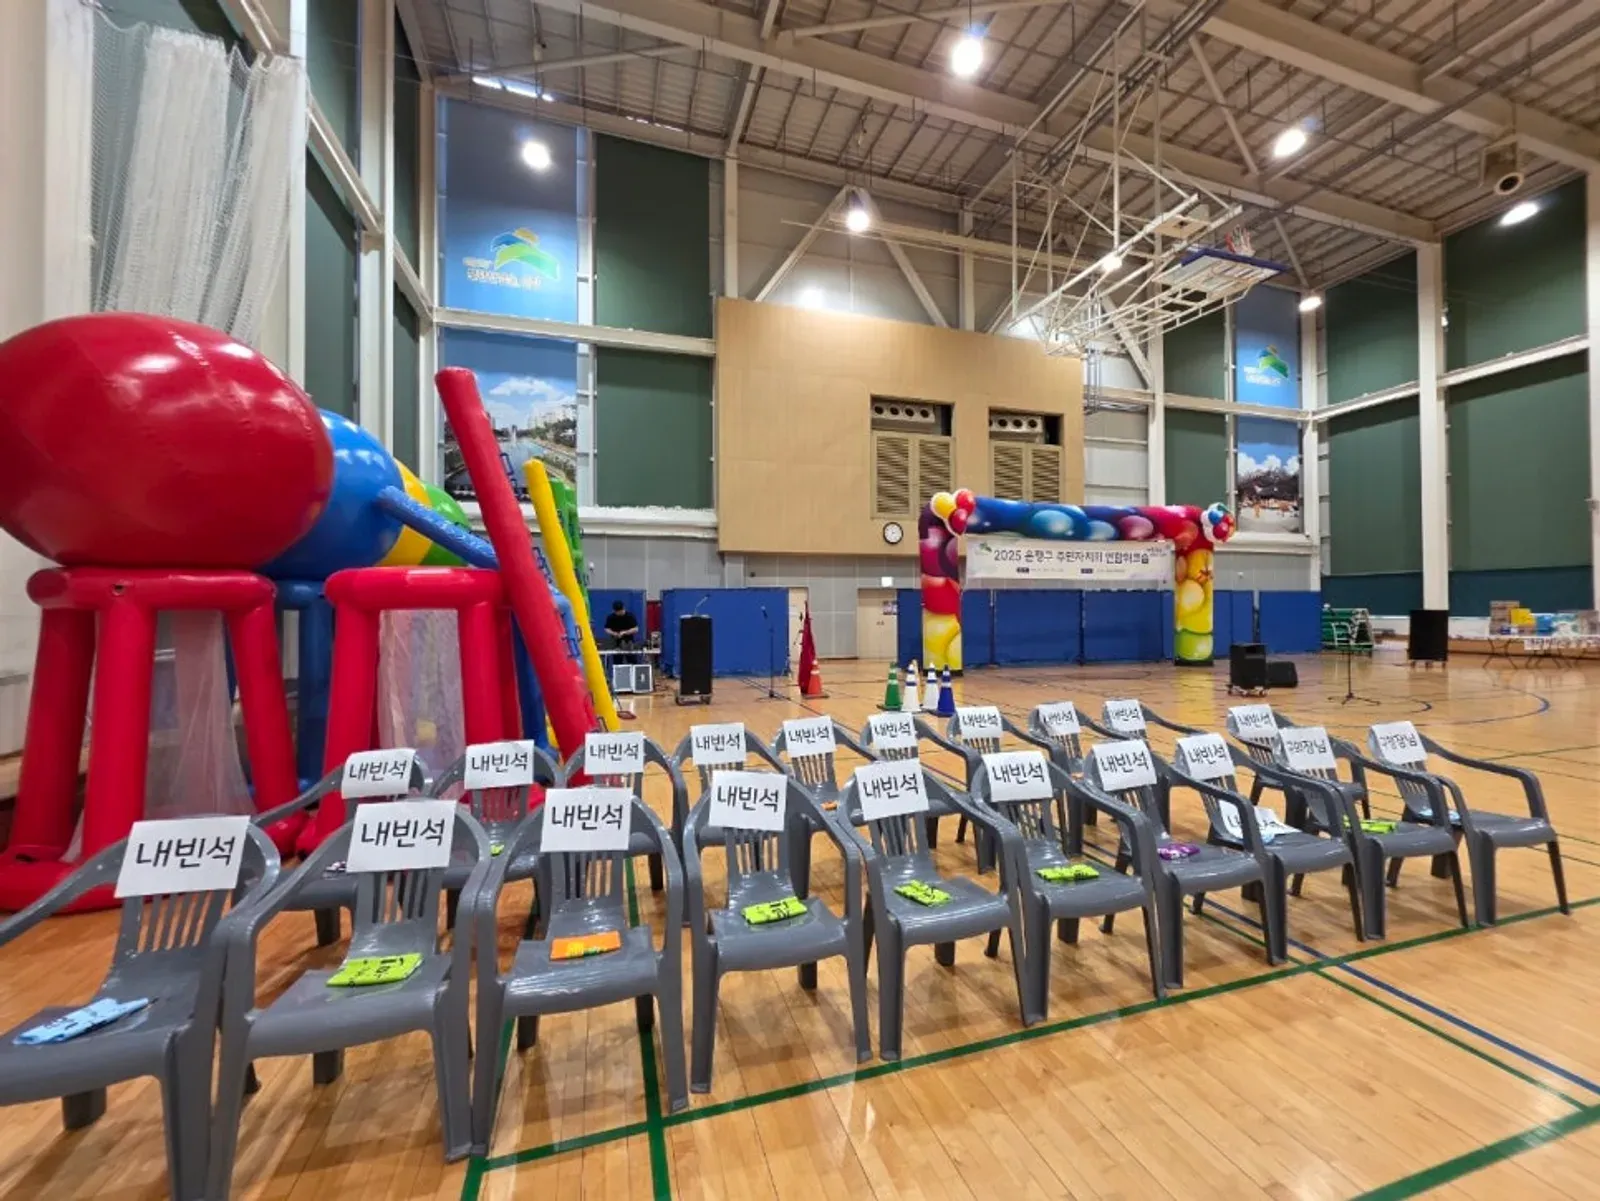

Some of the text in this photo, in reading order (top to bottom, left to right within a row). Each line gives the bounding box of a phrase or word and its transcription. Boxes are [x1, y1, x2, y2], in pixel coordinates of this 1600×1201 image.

[994, 549, 1022, 562] 2025
[1024, 549, 1054, 563] 은평구
[963, 713, 1000, 729] 내빈석
[1045, 710, 1075, 728] 내빈석
[1238, 713, 1273, 730] 내빈석
[789, 725, 832, 745] 내빈석
[875, 721, 914, 740] 내빈석
[590, 741, 640, 762] 내빈석
[695, 732, 741, 752] 내빈석
[472, 751, 530, 774] 내빈석
[1099, 750, 1151, 774] 내빈석
[1188, 742, 1227, 766] 내빈석
[348, 760, 408, 782] 내빈석
[991, 761, 1046, 785] 내빈석
[861, 773, 919, 801] 내빈석
[716, 785, 780, 815] 내빈석
[551, 803, 624, 831] 내빈석
[360, 816, 446, 850] 내빈석
[135, 835, 236, 871] 내빈석
